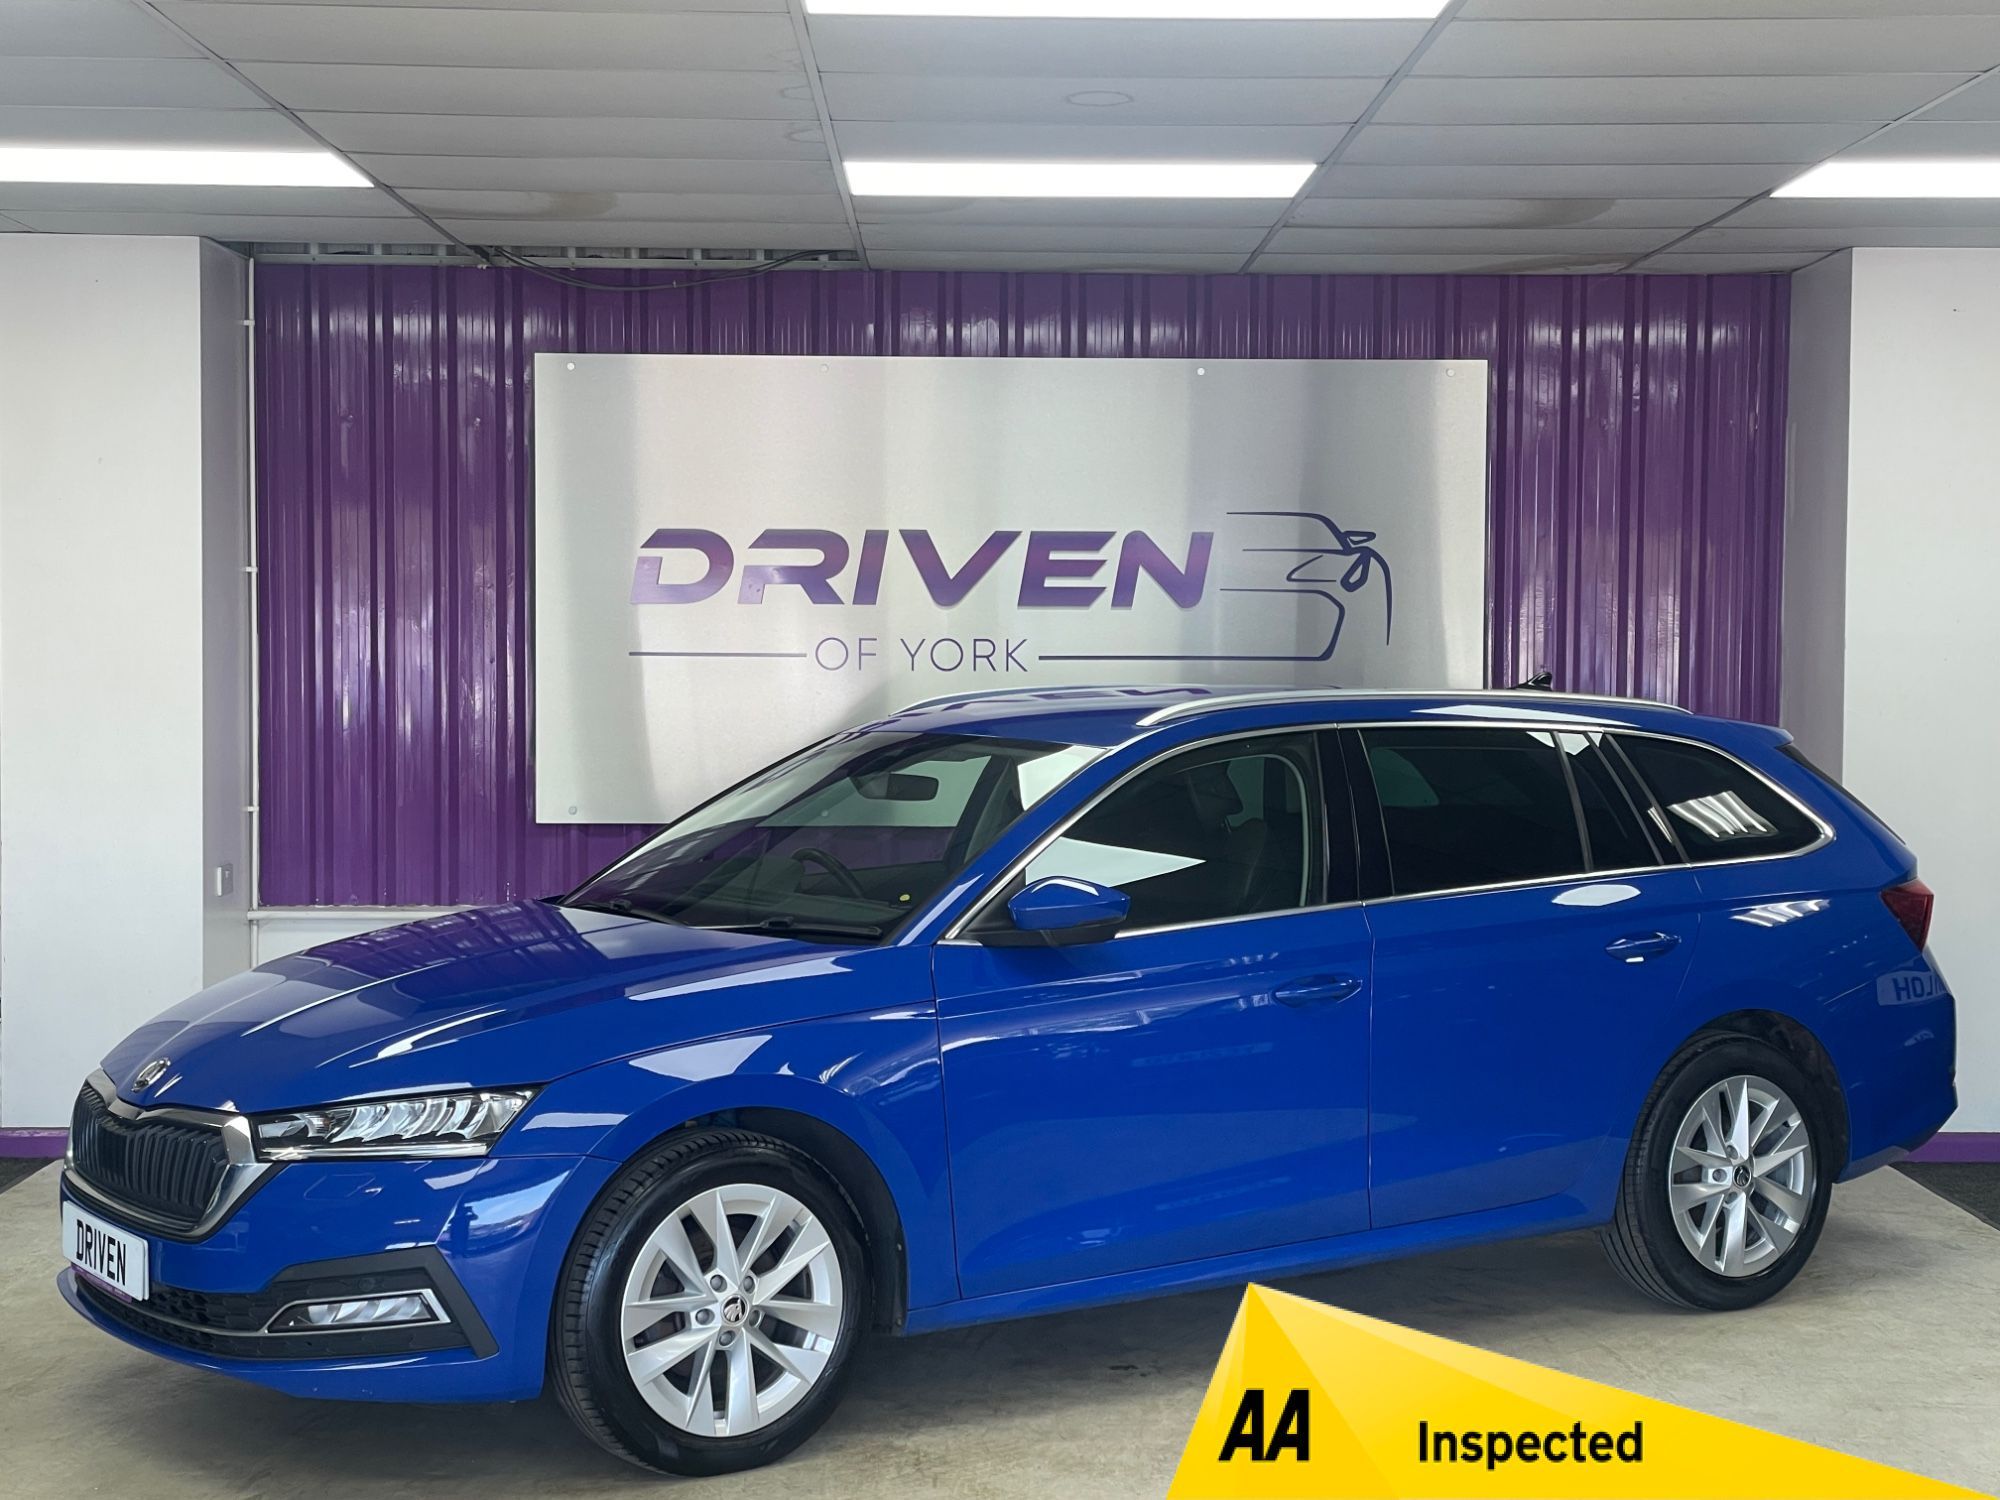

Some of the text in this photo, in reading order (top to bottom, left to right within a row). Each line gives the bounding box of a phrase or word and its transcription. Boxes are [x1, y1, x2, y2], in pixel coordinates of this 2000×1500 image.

[631, 528, 1214, 609] DRIVEN
[815, 637, 1028, 672] OF YORK
[76, 1218, 126, 1287] DRIVEN
